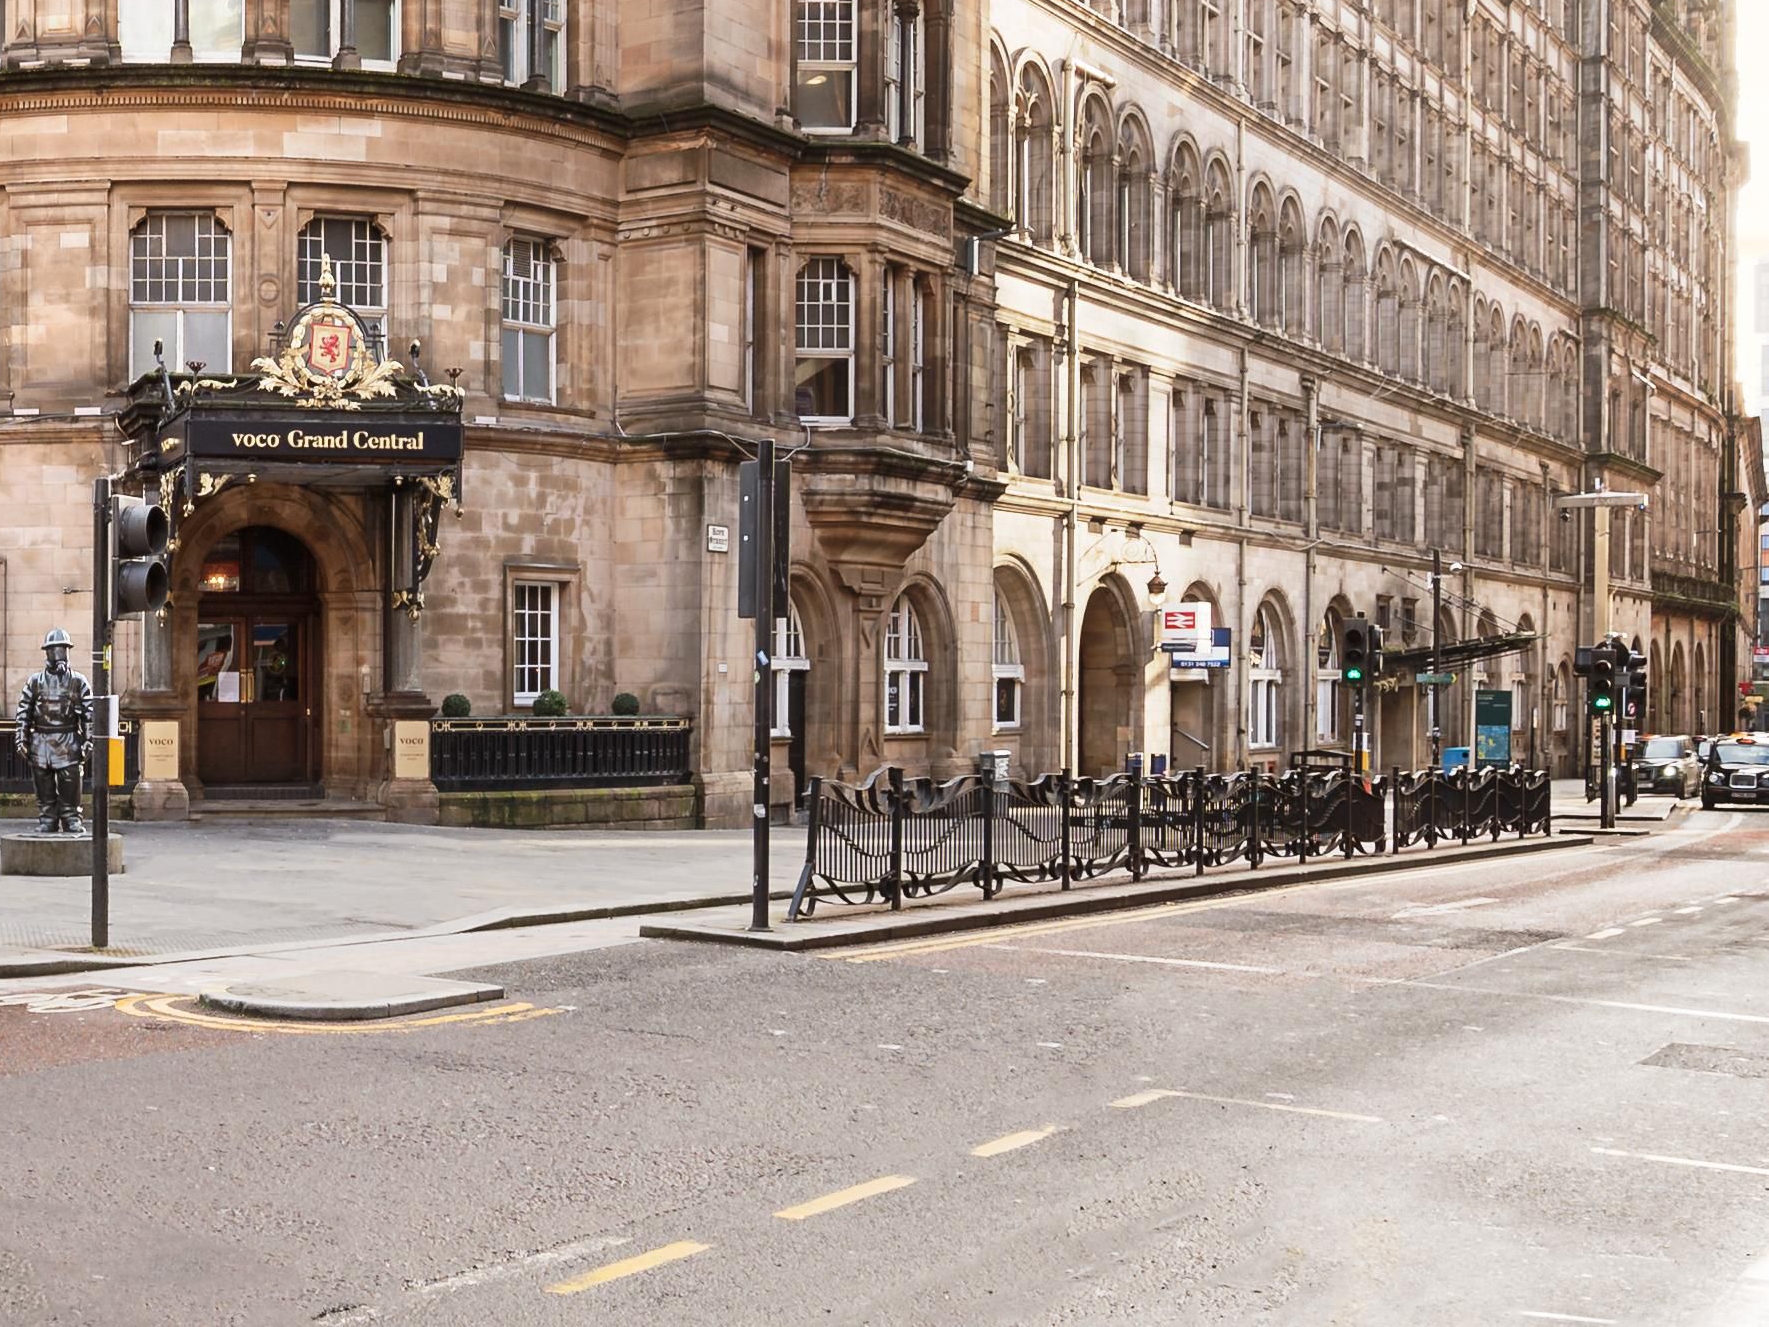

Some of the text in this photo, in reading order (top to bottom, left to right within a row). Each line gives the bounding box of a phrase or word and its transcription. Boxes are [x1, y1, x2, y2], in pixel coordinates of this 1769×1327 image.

[231, 430, 424, 450] voco Grand Central
